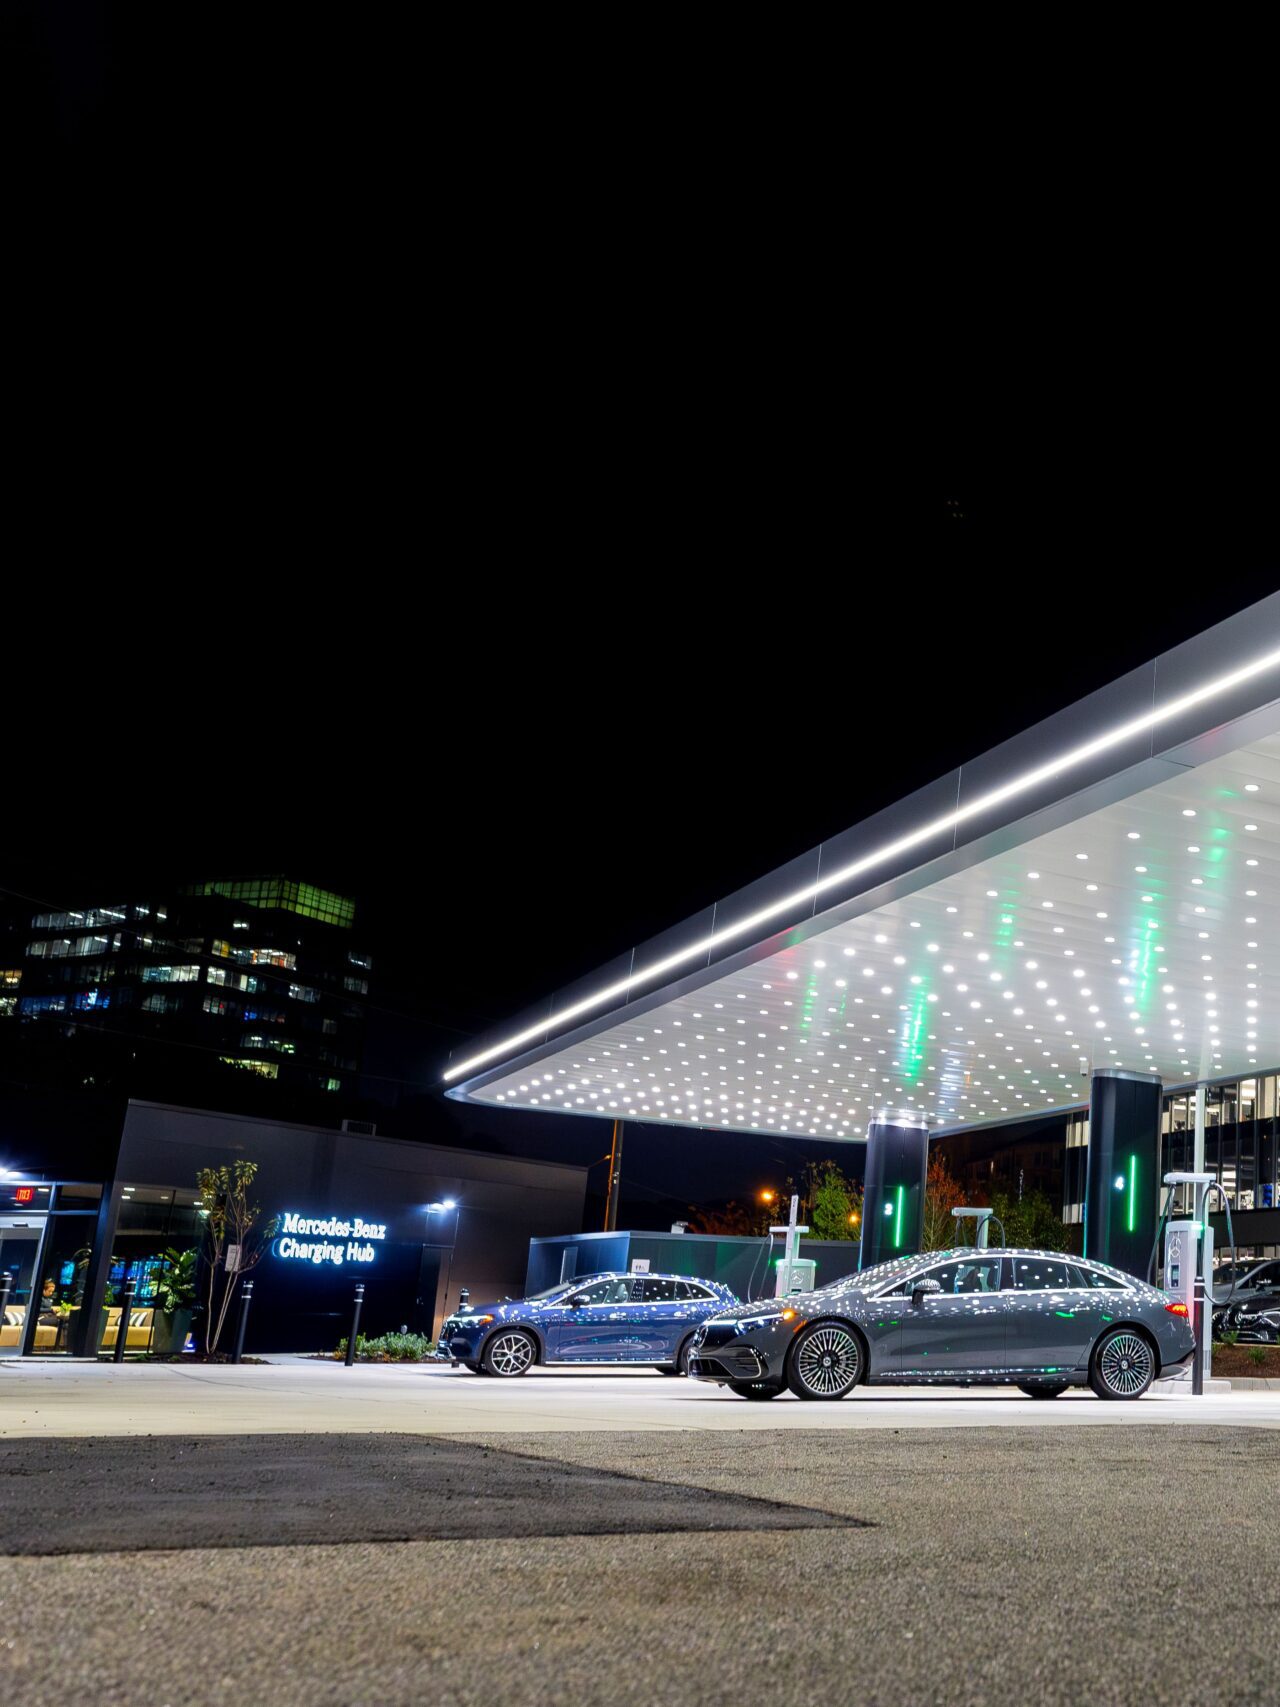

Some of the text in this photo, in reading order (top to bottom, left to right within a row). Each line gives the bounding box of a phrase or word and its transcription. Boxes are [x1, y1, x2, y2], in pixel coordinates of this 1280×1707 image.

[1115, 1176, 1124, 1190] 4
[282, 1213, 386, 1239] Mercedes-Benz
[280, 1238, 375, 1264] Charging Hub
